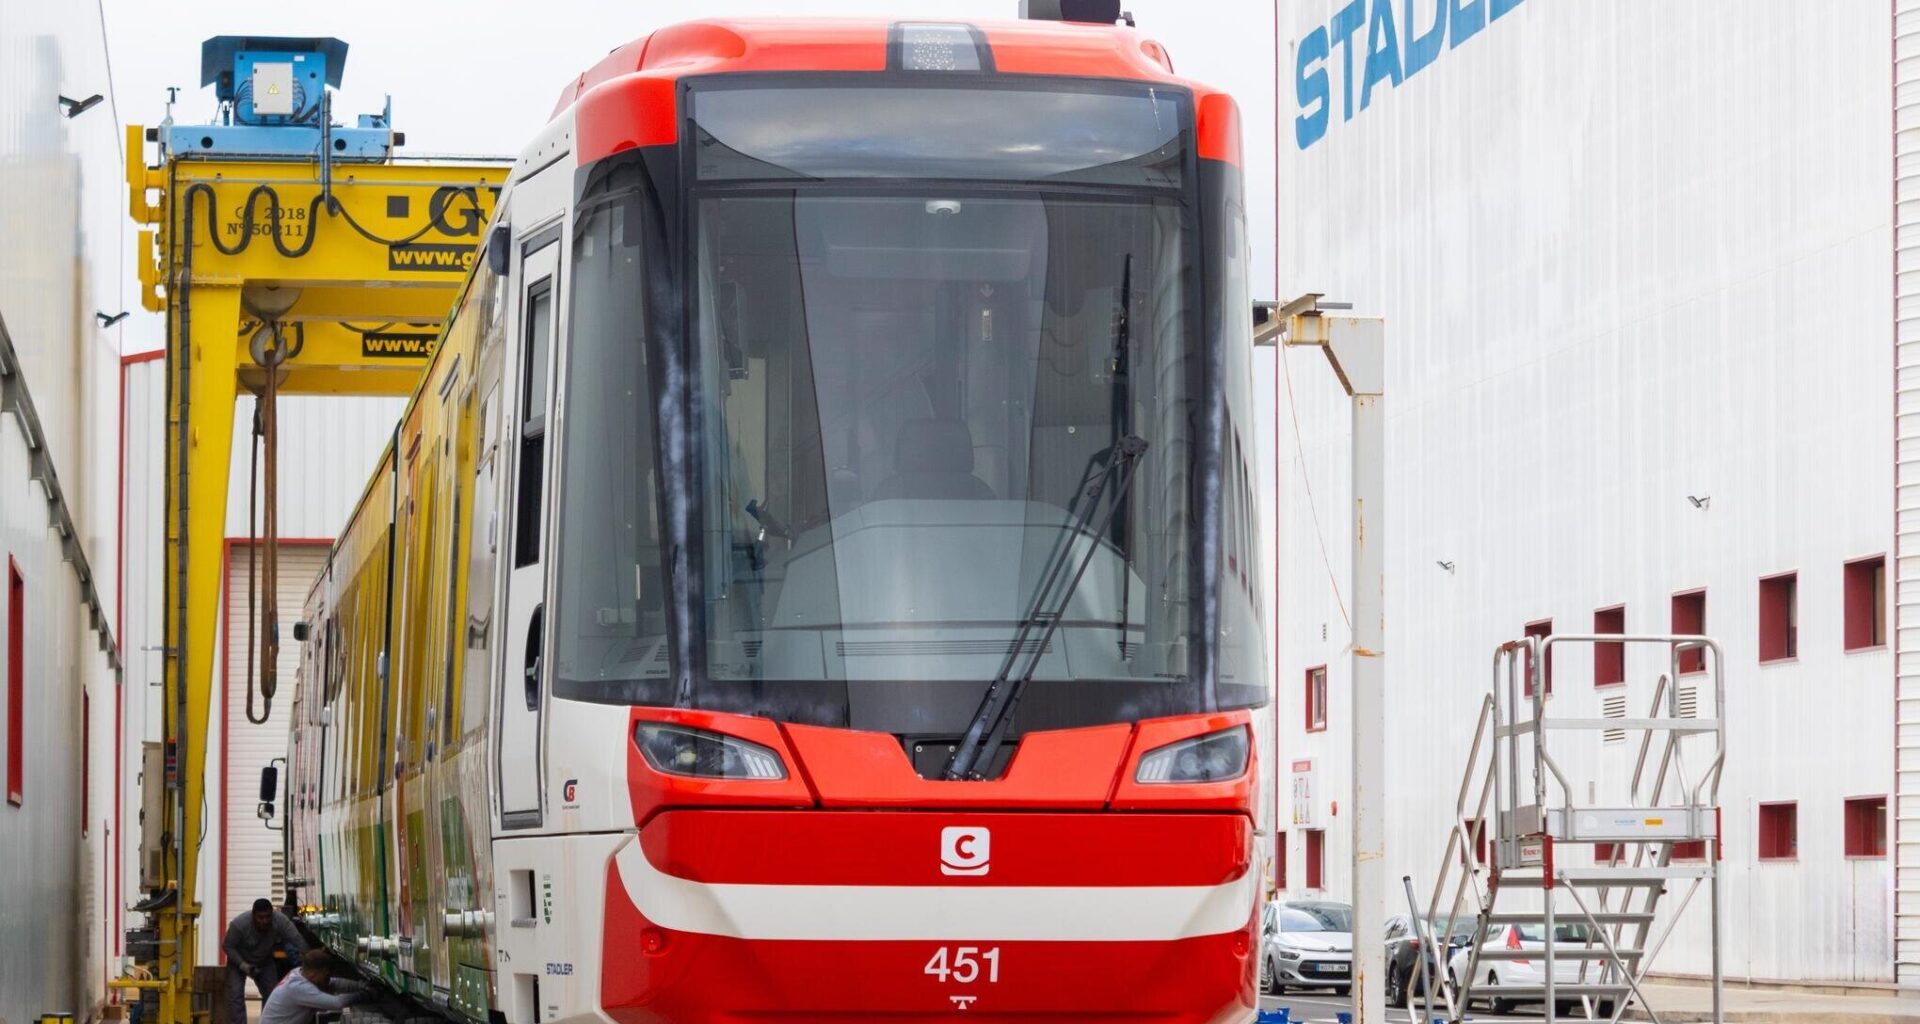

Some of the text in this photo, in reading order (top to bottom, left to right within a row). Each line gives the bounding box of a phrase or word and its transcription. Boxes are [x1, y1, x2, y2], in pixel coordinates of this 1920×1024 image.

[429, 186, 503, 237] G
[546, 963, 574, 976] STADLER
[924, 947, 1000, 983] 451
